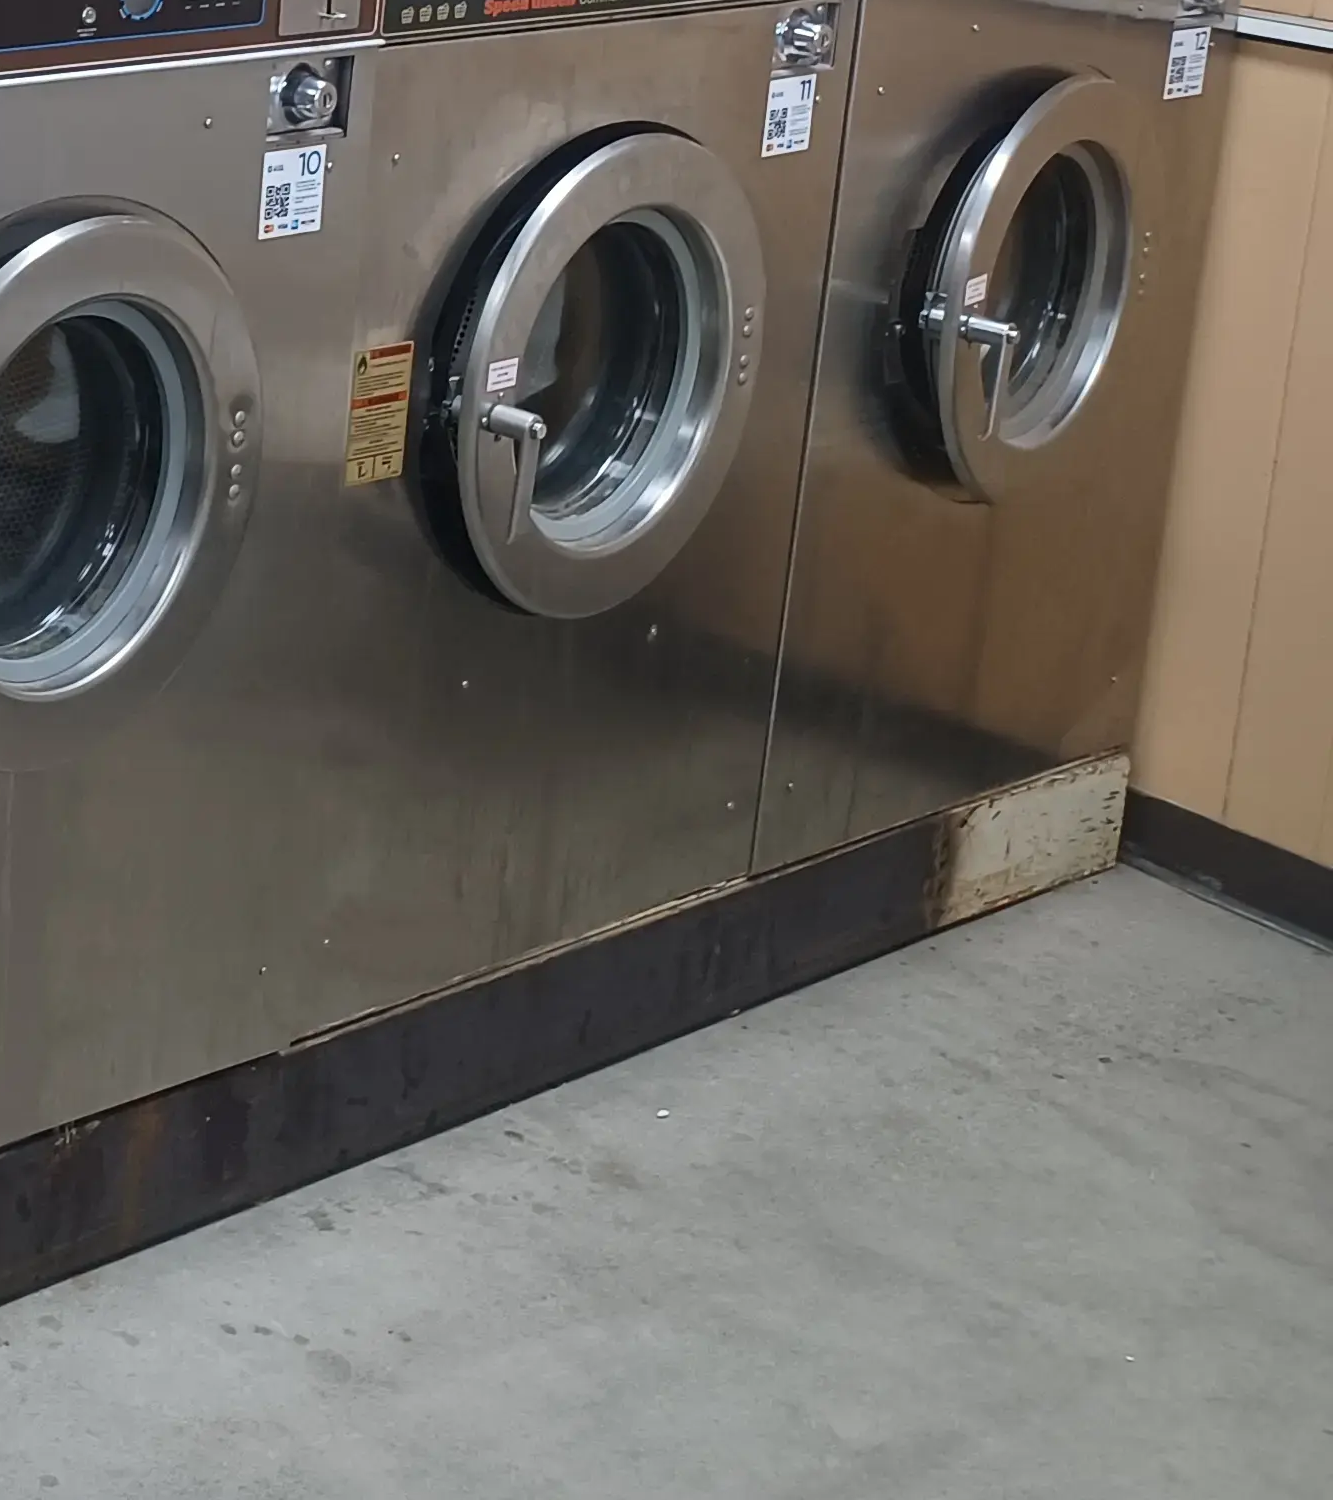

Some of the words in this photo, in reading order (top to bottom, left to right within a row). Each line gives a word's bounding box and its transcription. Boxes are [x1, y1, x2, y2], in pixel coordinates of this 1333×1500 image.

[1195, 31, 1207, 50] 12
[800, 79, 812, 101] 11
[299, 151, 321, 176] 10
